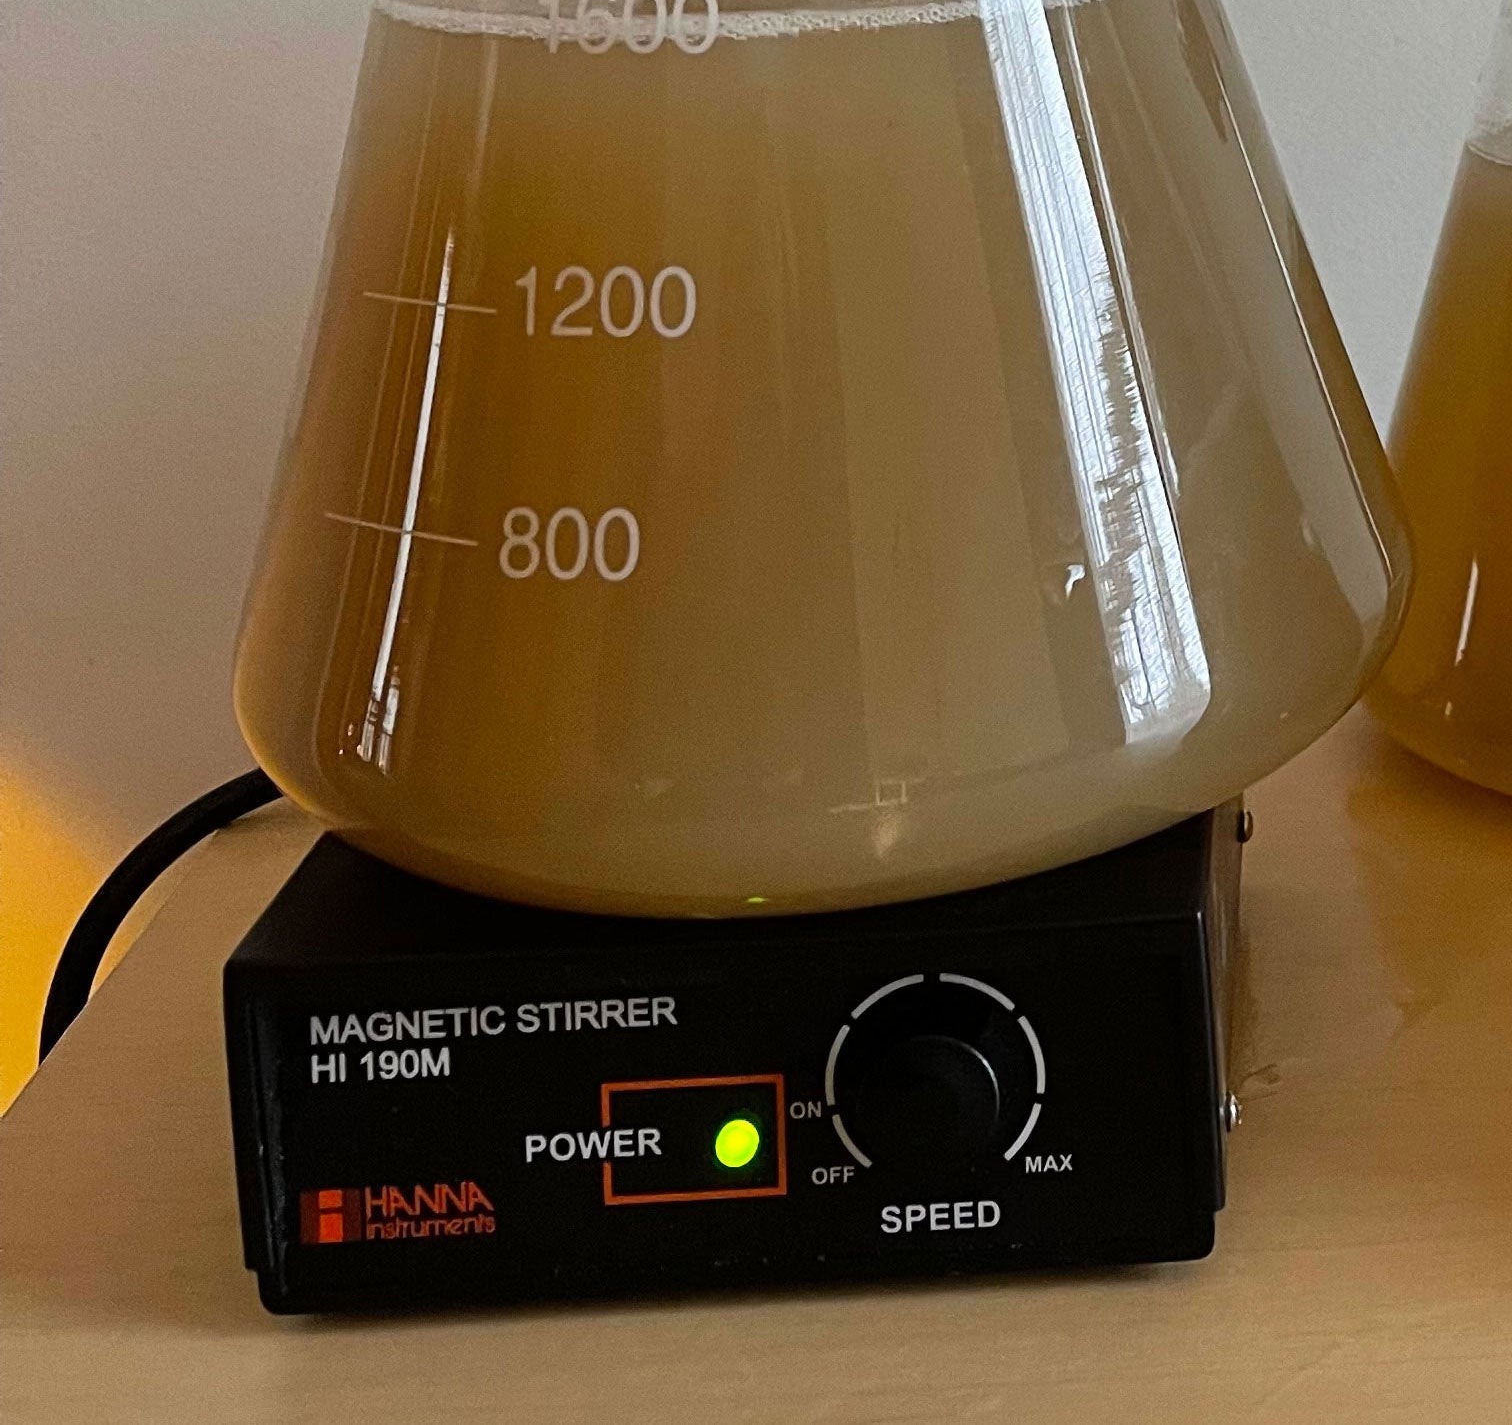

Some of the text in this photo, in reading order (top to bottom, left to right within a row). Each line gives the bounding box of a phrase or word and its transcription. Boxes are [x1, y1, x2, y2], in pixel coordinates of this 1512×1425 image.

[515, 265, 697, 338] 1200
[499, 506, 641, 581] 800
[310, 996, 678, 1046] MAGNETIC STIRRER
[310, 1047, 451, 1083] HI 190M
[789, 1100, 823, 1120] ON
[525, 1127, 662, 1162] POWER
[811, 1165, 855, 1185] OFF
[1025, 1153, 1074, 1174] MAX
[364, 1179, 495, 1217] HANNA
[880, 1199, 1001, 1234] SPEED
